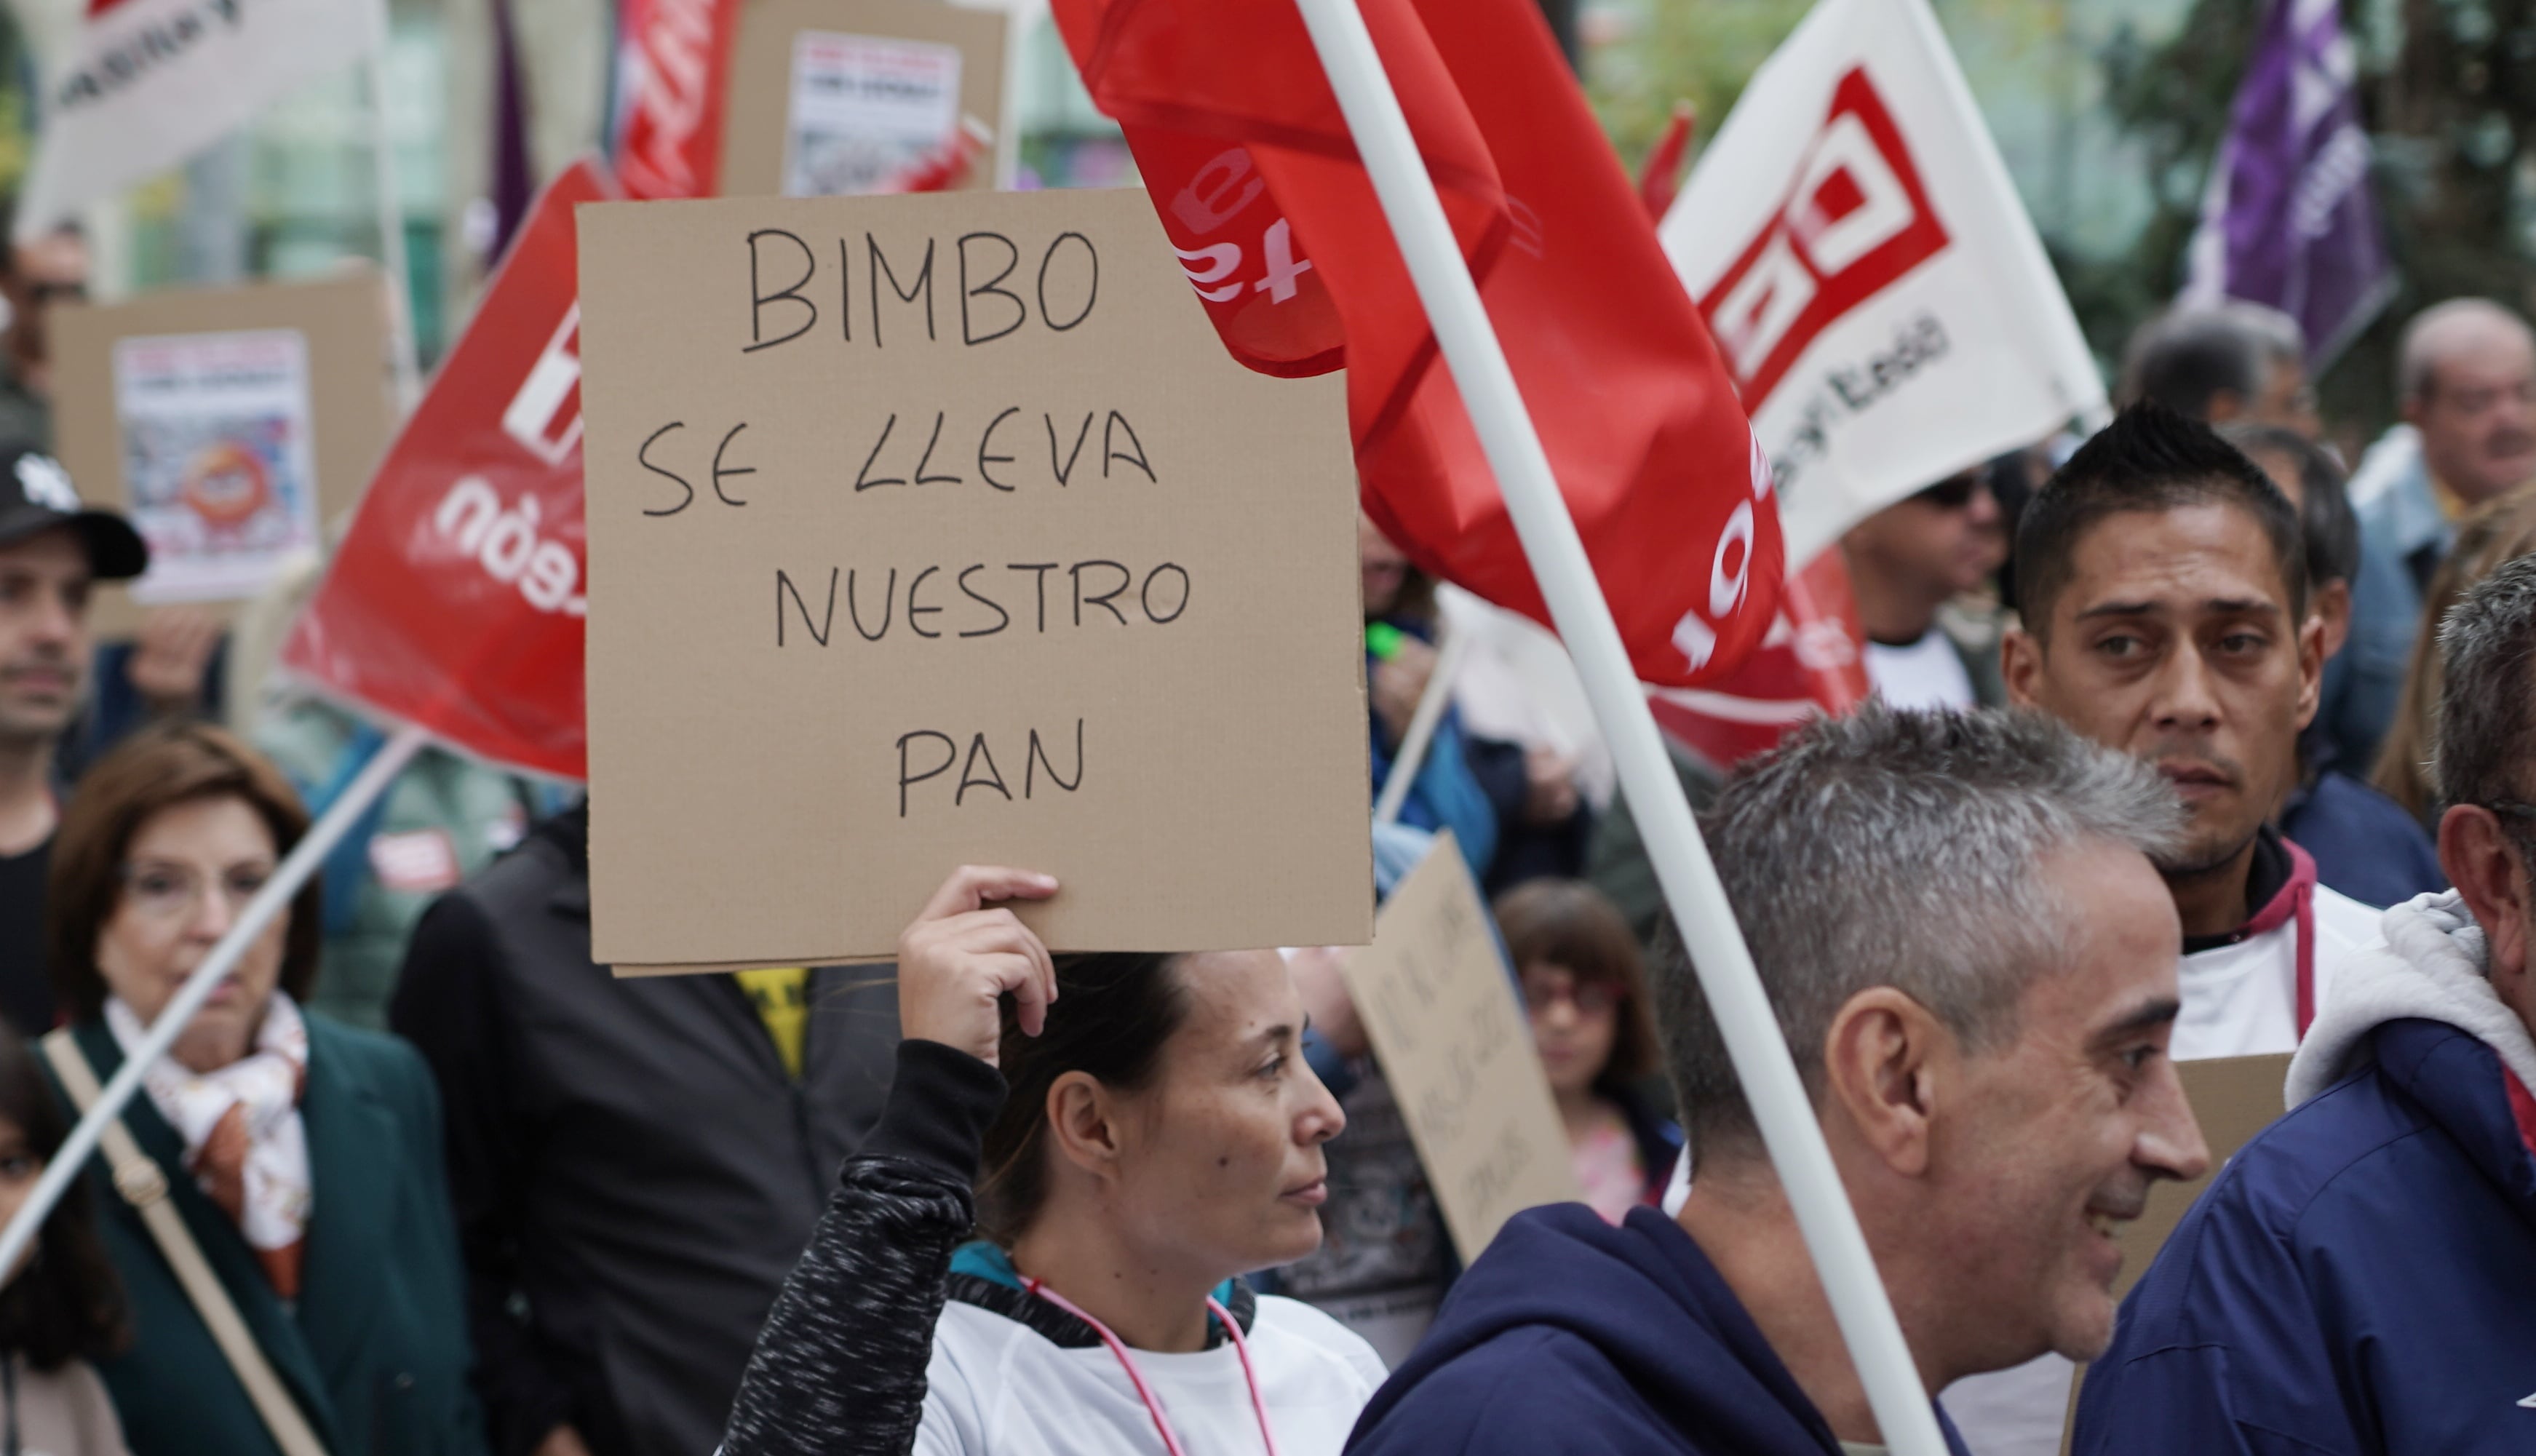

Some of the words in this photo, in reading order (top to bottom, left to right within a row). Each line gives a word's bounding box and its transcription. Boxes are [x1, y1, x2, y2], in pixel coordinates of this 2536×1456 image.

[741, 228, 1100, 354] BIMBO
[637, 421, 758, 518] SE
[854, 406, 1158, 493] LLEVA
[776, 559, 1191, 648] NUESTRO
[895, 717, 1084, 819] PAN
